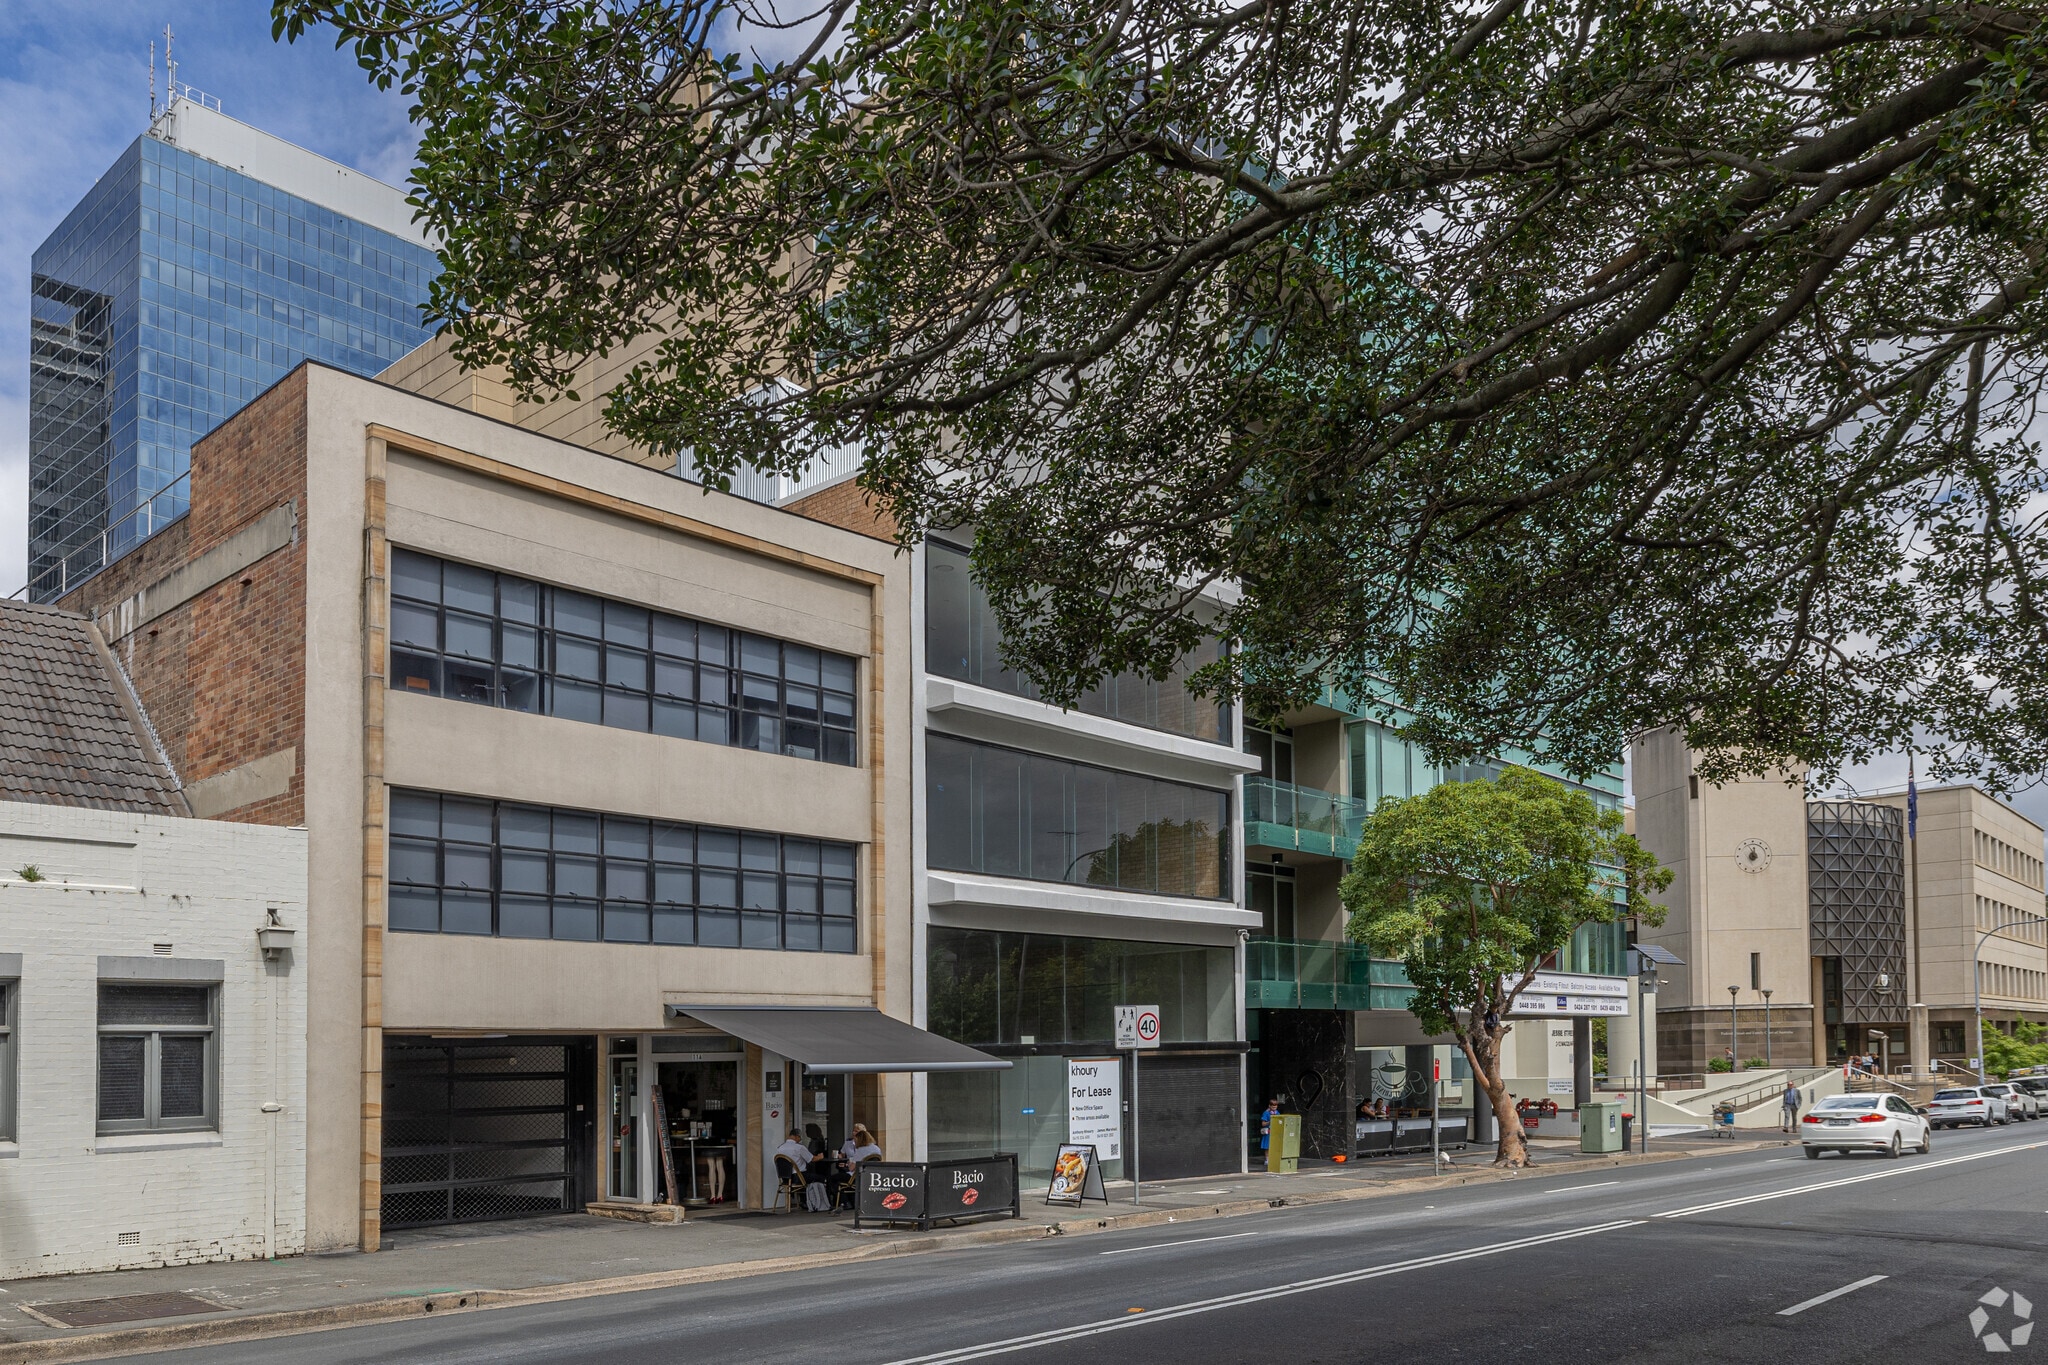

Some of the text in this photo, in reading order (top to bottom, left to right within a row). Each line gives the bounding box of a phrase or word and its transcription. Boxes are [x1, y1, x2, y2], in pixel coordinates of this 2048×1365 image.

[1543, 981, 1558, 990] Existing
[1140, 1019, 1157, 1033] 40
[1071, 1065, 1098, 1078] khoury
[1072, 1086, 1112, 1098] For Lease
[765, 1101, 783, 1109] Bacio
[870, 1172, 915, 1188] Bacio
[953, 1169, 984, 1185] Bacio
